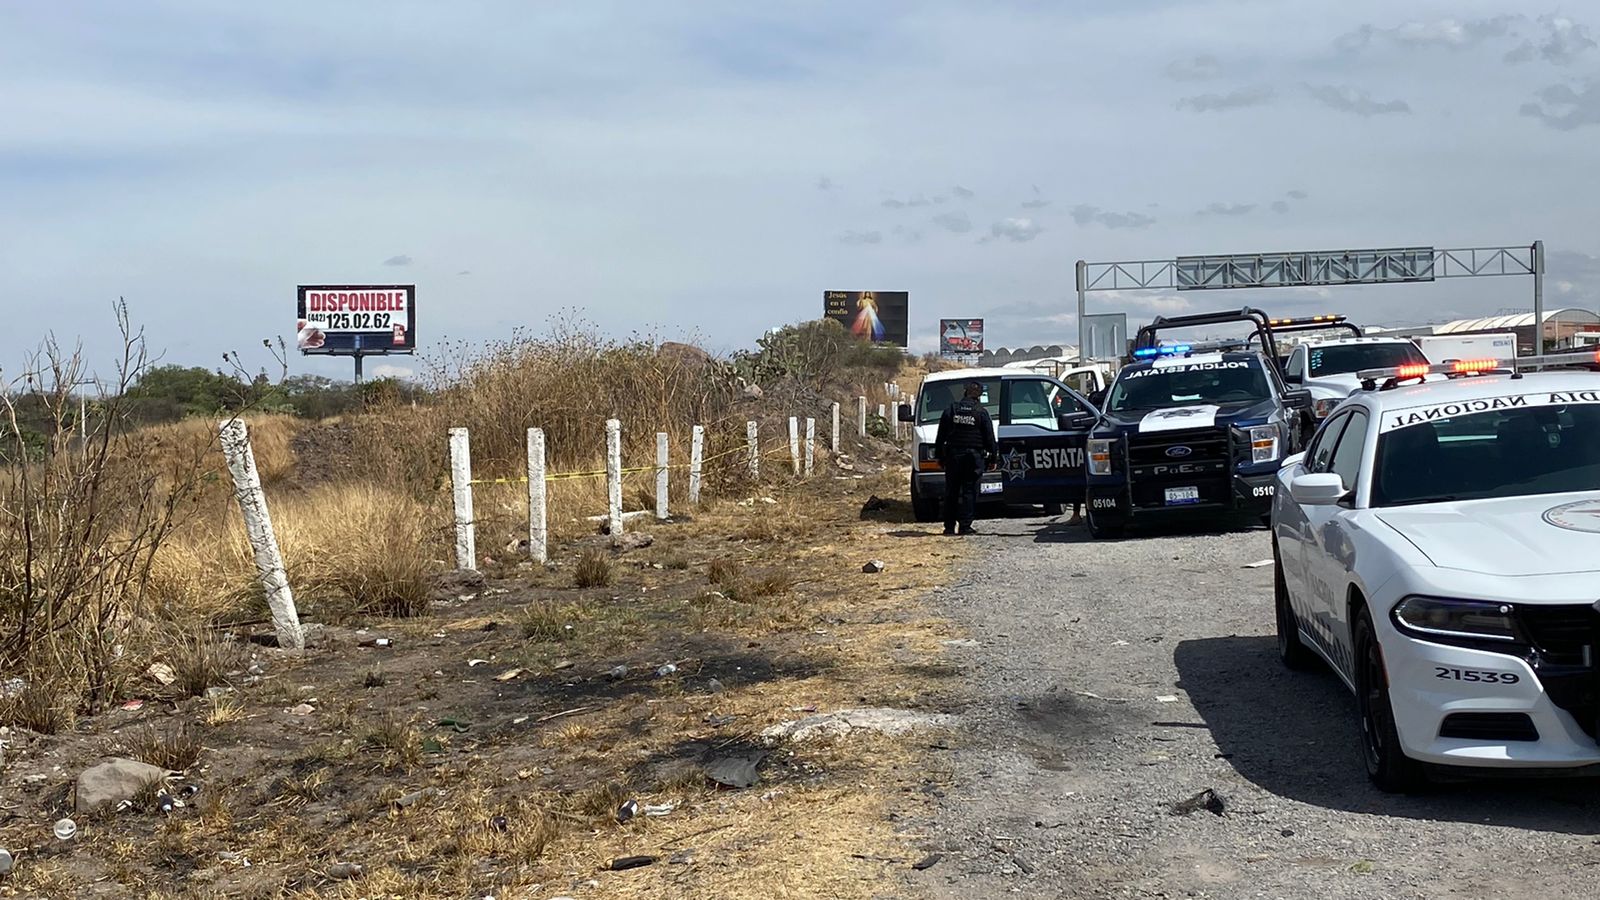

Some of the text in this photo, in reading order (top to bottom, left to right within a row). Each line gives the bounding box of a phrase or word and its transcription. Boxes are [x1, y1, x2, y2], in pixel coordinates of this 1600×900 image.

[310, 292, 404, 312] DISPONIBLE
[308, 312, 391, 329] (442) 125.02.62
[1093, 498, 1116, 508] 05104
[1435, 667, 1520, 684] 21539
